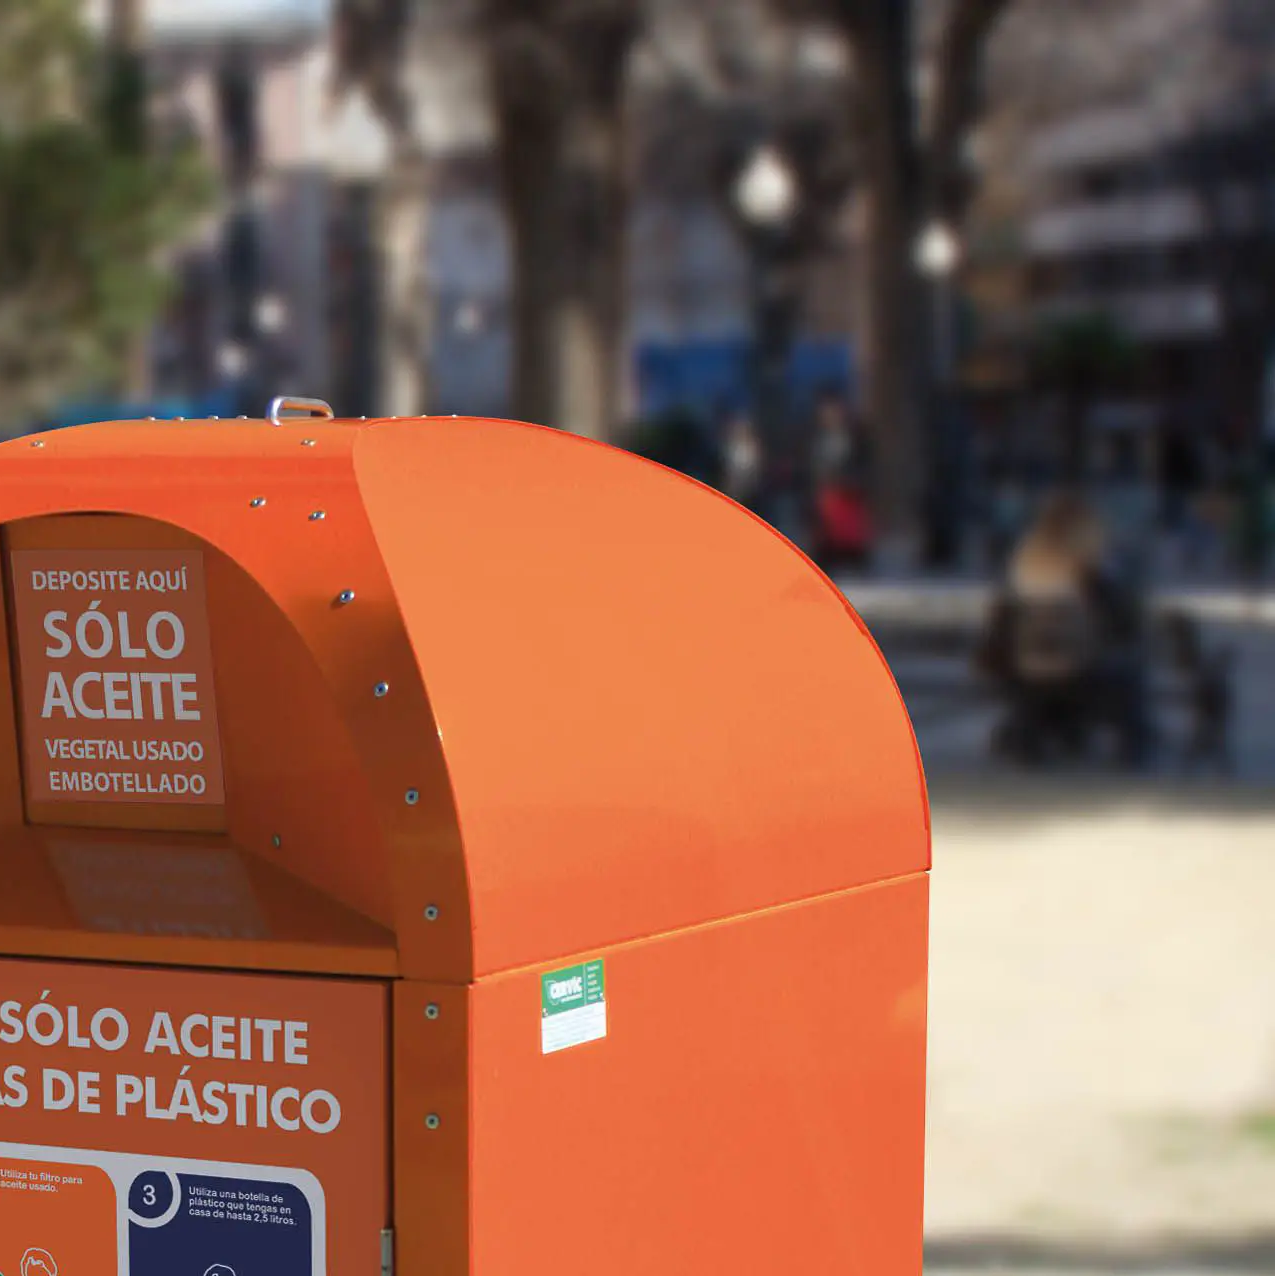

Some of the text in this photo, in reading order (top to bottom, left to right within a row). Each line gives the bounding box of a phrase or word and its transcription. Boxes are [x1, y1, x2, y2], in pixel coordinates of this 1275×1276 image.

[32, 567, 187, 592] DEPOSITE AQUÍ
[43, 600, 184, 659] SÓLO
[41, 672, 200, 720] ACEITE
[45, 739, 203, 761] VEGETAL USADO
[49, 771, 206, 794] EMBOTELLADO
[144, 1012, 308, 1064] ACEITE
[42, 1069, 100, 1113] DE
[116, 1066, 340, 1134] PLÁSTICO
[0, 1169, 83, 1185] Utiliza tu filtro para
[0, 1180, 58, 1192] aceite usado.
[143, 1184, 156, 1205] 3
[189, 1186, 217, 1197] Utiliza
[239, 1191, 269, 1202] botella
[272, 1194, 283, 1203] de
[189, 1197, 291, 1214] plástico que tengas en
[189, 1209, 297, 1225] casa de hasta 2,5 litros.
